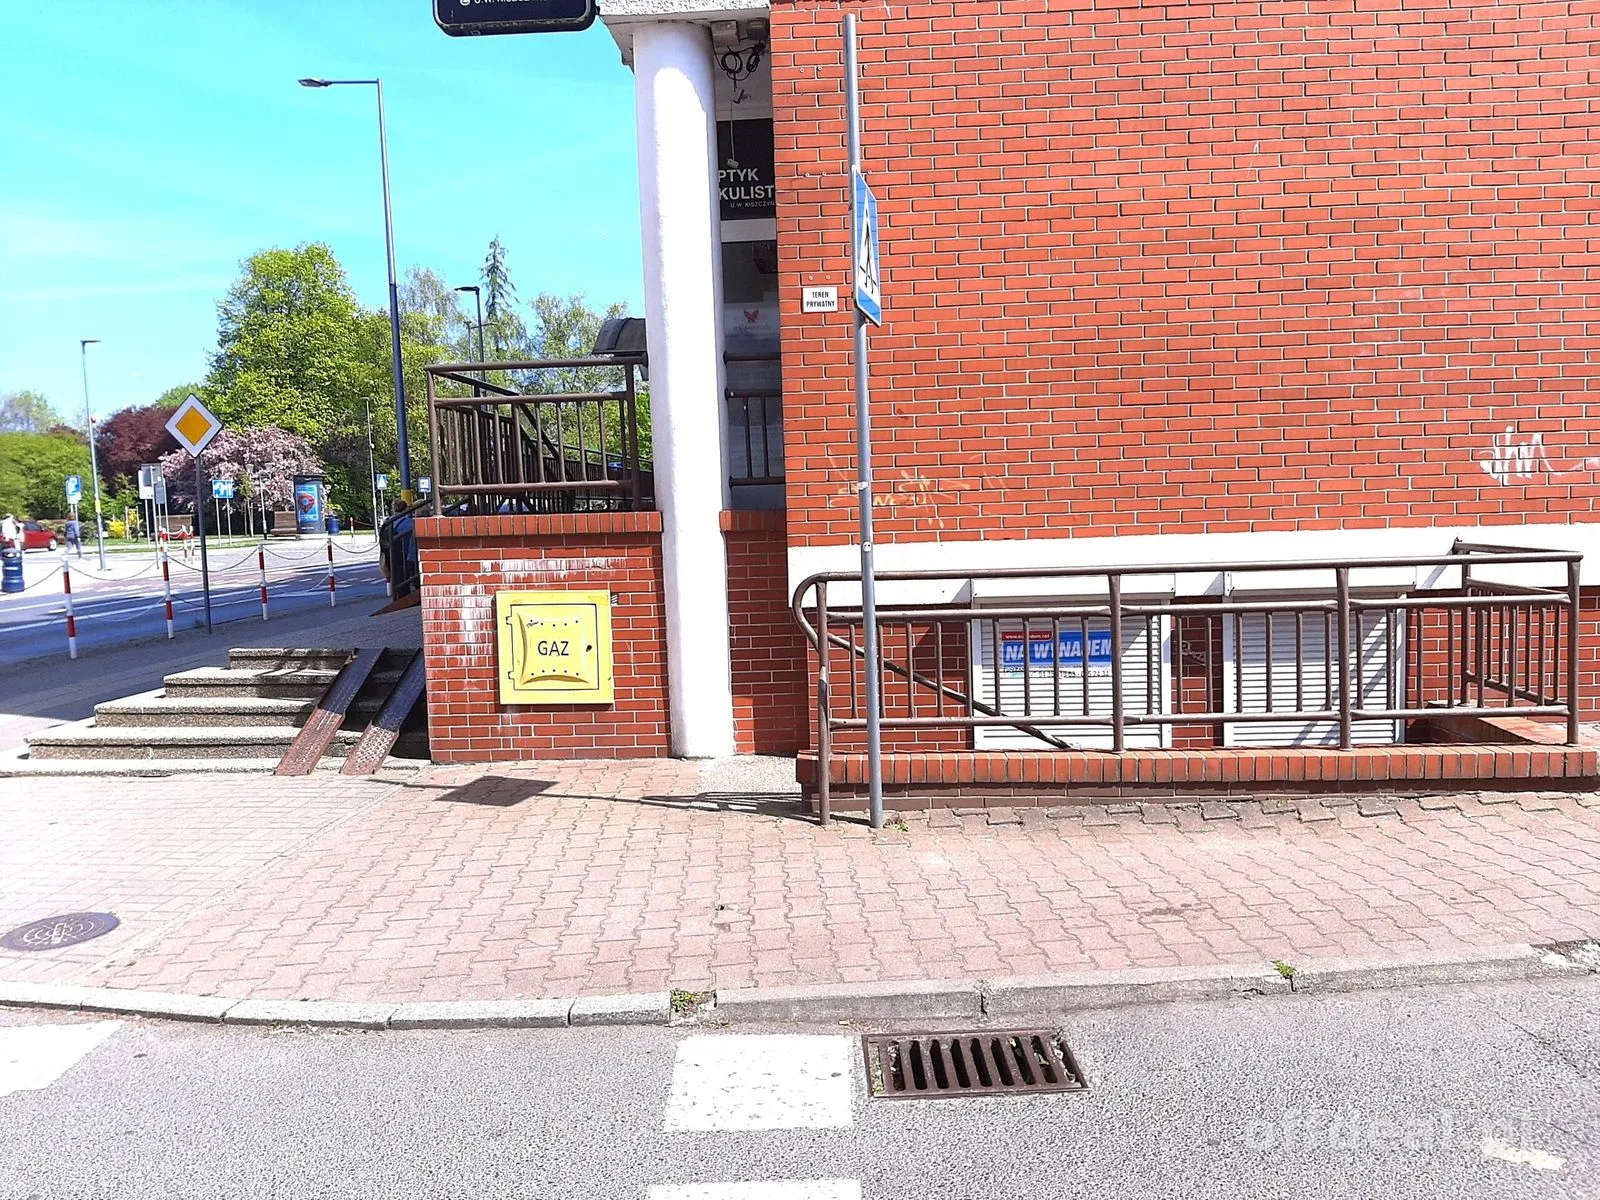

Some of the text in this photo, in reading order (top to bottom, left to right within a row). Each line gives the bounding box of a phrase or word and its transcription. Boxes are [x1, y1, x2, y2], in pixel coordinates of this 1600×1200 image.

[806, 300, 835, 308] PRYWATNY
[537, 640, 570, 656] GAZ
[1005, 644, 1026, 661] NA
